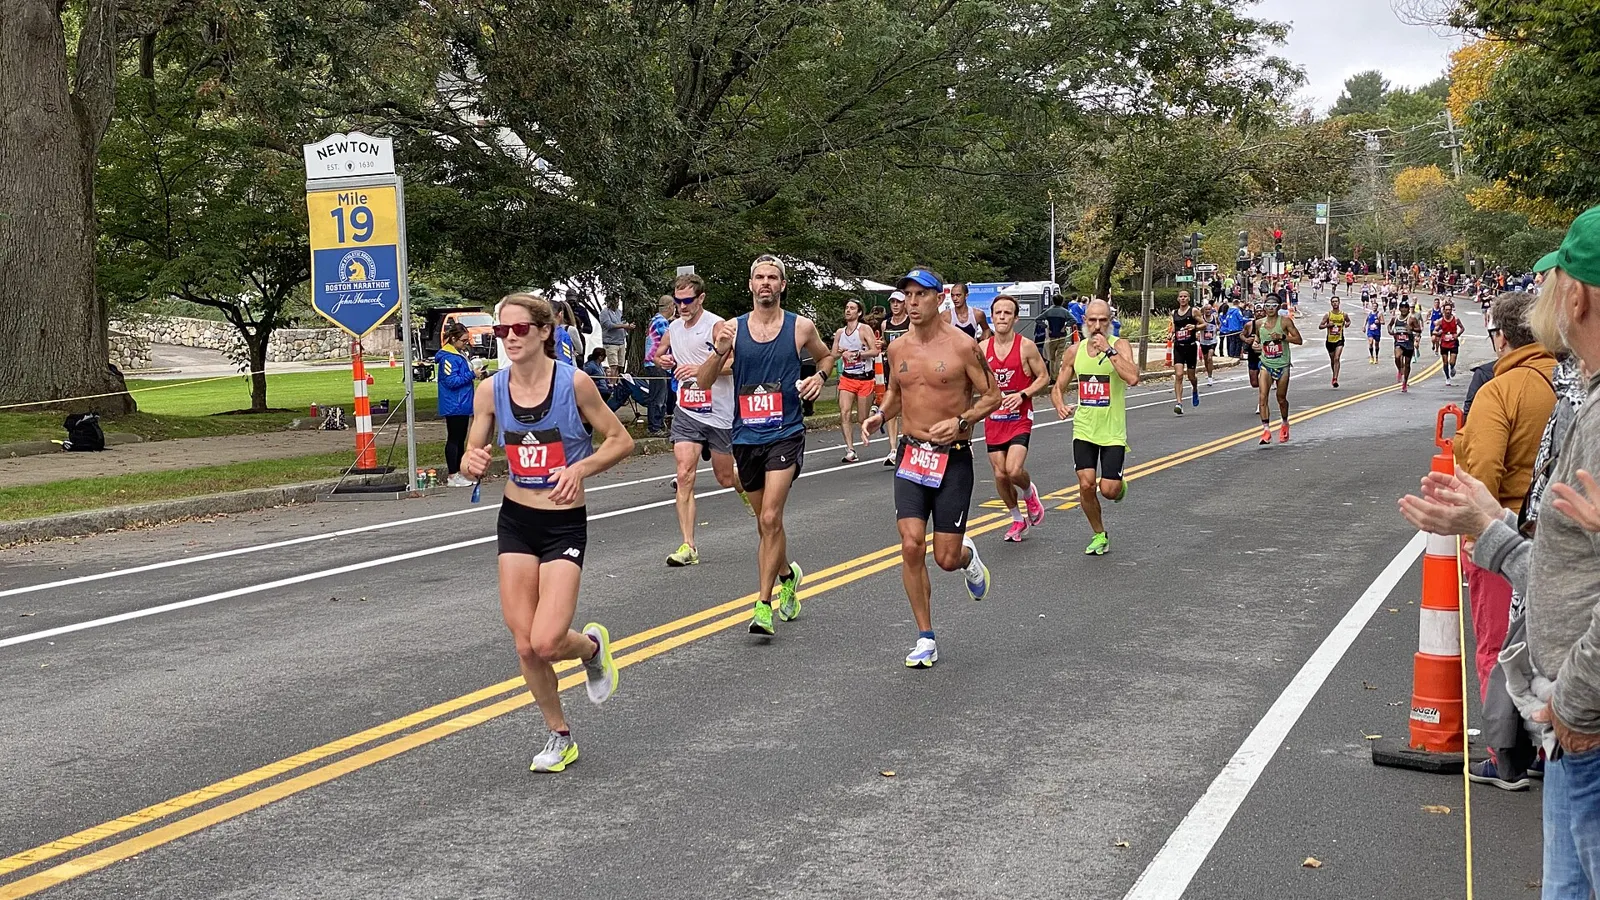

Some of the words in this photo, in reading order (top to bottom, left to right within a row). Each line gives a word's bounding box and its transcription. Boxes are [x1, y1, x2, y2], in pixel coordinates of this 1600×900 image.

[317, 141, 379, 160] NEWTON
[327, 163, 340, 171] EST.
[359, 161, 374, 169] 1630
[338, 192, 368, 206] Mile
[330, 206, 374, 243] 19
[325, 283, 352, 291] BOSTON
[353, 281, 390, 290] MARATHON
[331, 293, 355, 314] John
[353, 291, 386, 308] Hancock
[999, 373, 1005, 381] P
[683, 389, 706, 403] 2855
[1082, 382, 1104, 396] 1474
[747, 394, 774, 412] 1241
[517, 445, 548, 468] 827
[910, 447, 940, 471] 3455
